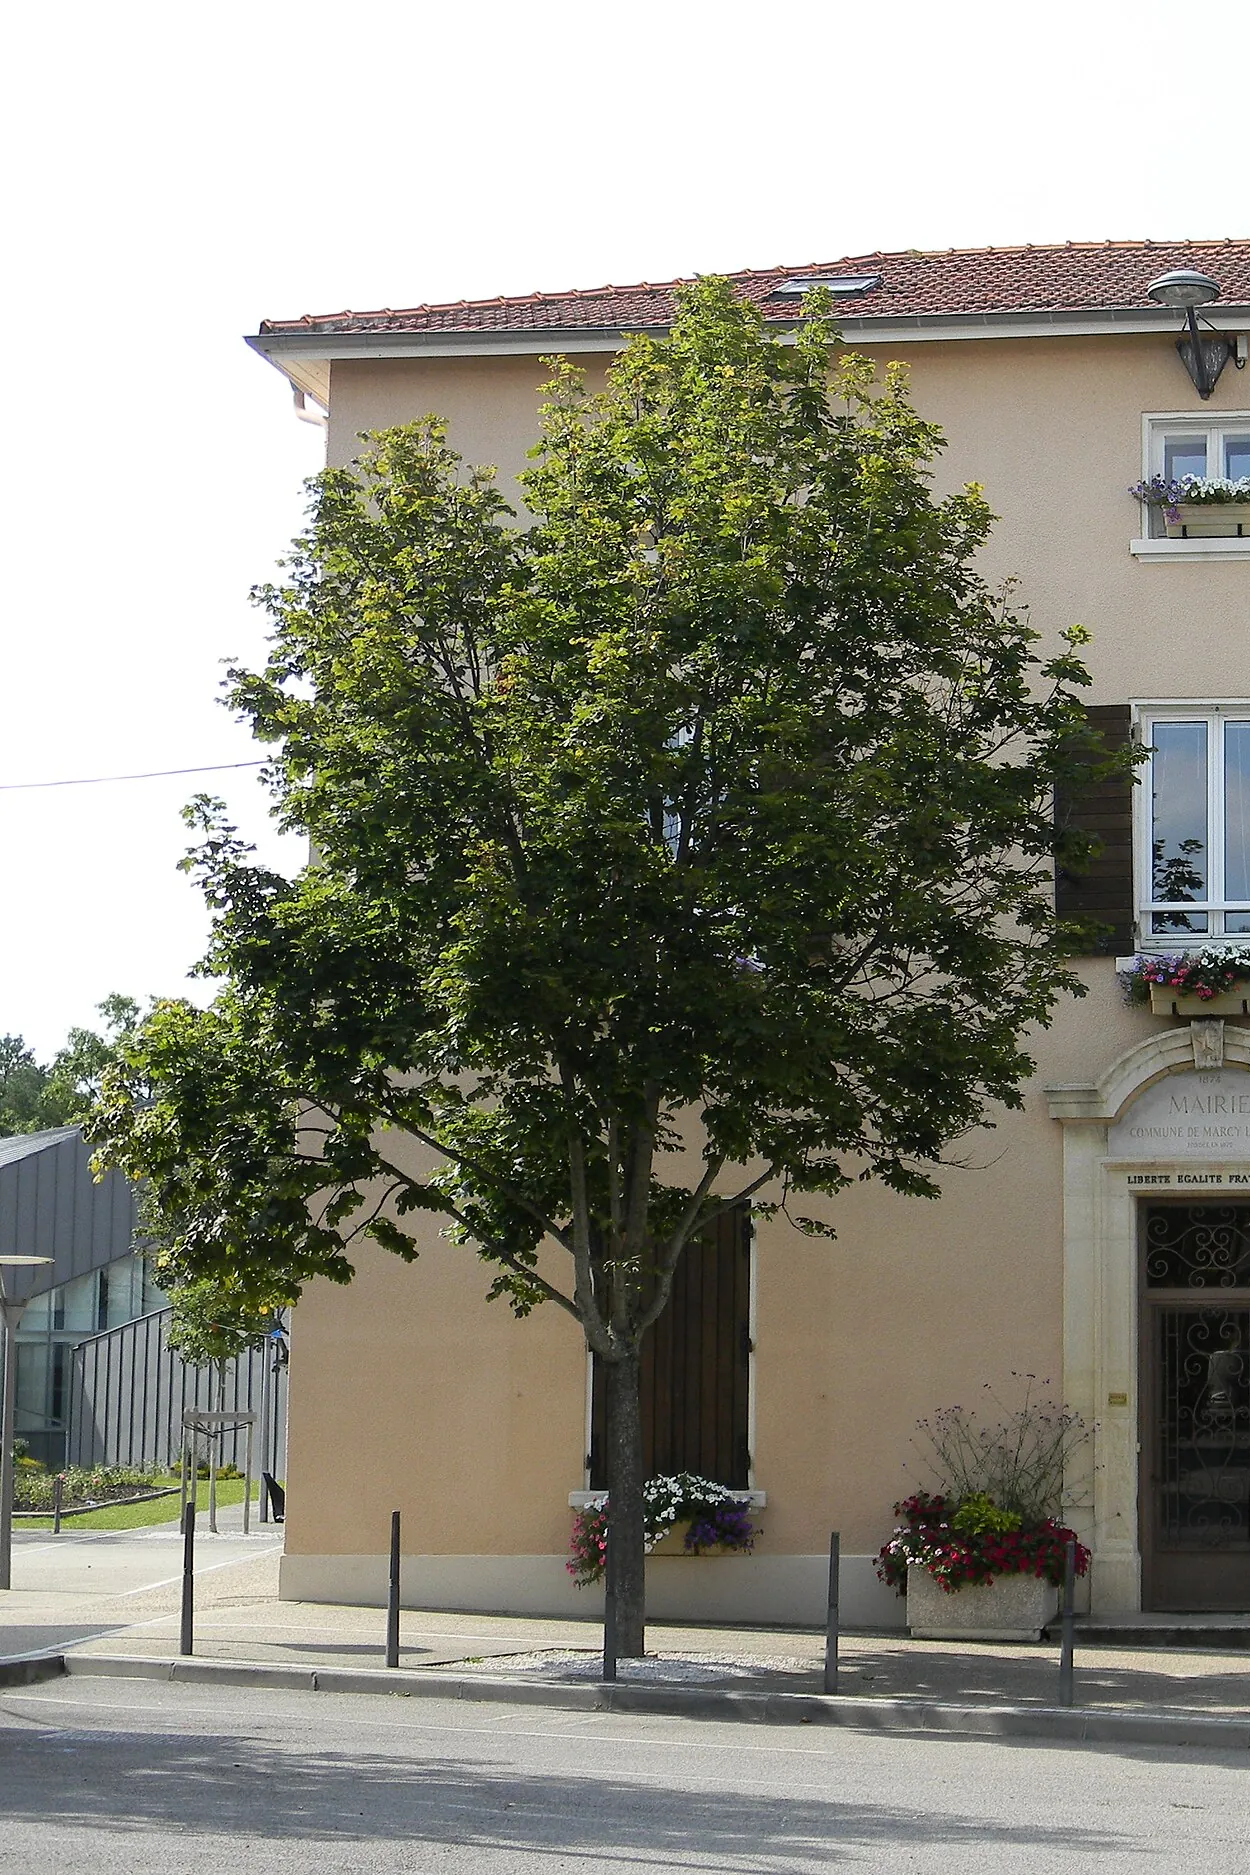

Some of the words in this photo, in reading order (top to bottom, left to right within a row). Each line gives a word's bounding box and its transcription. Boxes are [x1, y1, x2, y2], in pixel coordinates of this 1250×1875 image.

[1129, 1126, 1183, 1138] COMMUNE
[1187, 1126, 1200, 1137] DE
[1202, 1126, 1241, 1137] MARCY
[1127, 1175, 1171, 1184] LIBERTE
[1177, 1174, 1222, 1184] EGALITE
